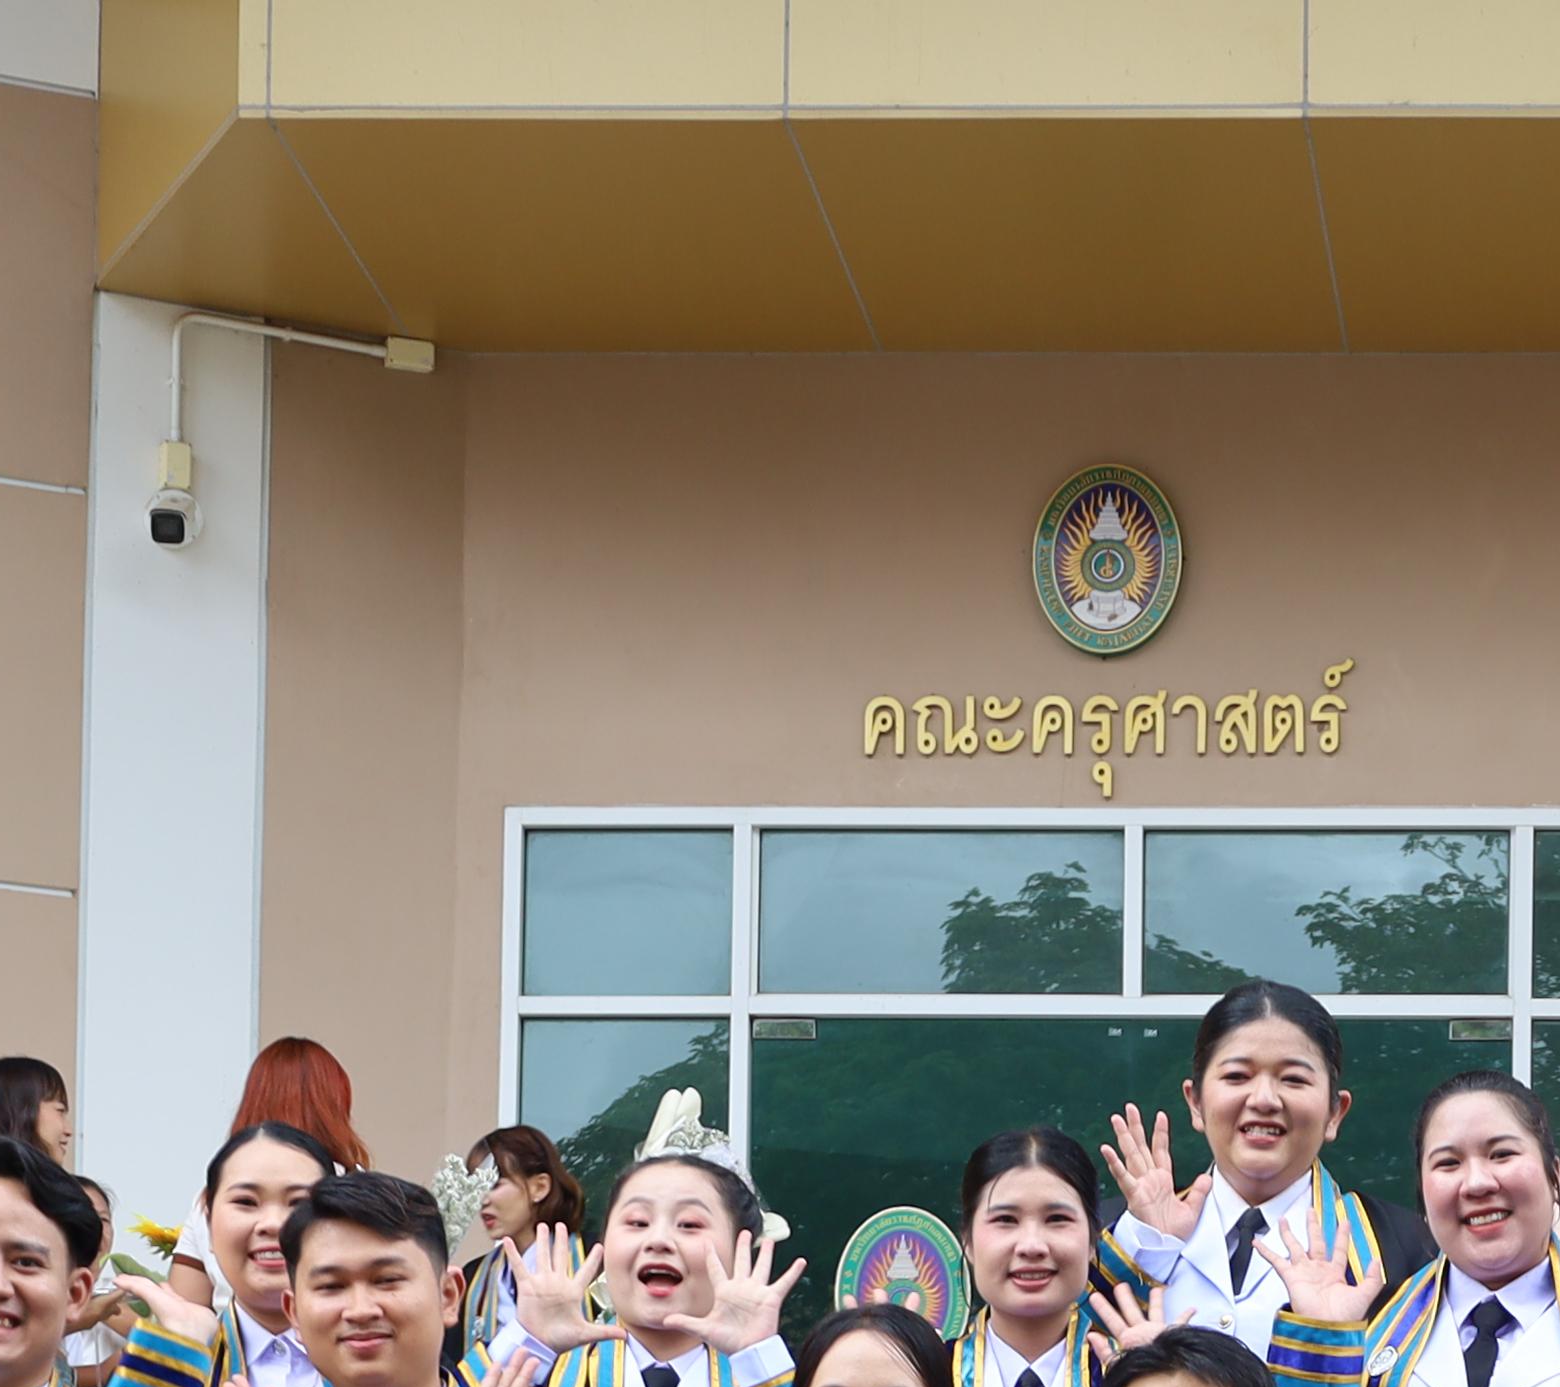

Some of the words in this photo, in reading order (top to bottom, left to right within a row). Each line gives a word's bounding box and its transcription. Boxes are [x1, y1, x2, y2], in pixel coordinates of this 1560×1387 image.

[862, 658, 1354, 797] คณะครุศาสตร์
